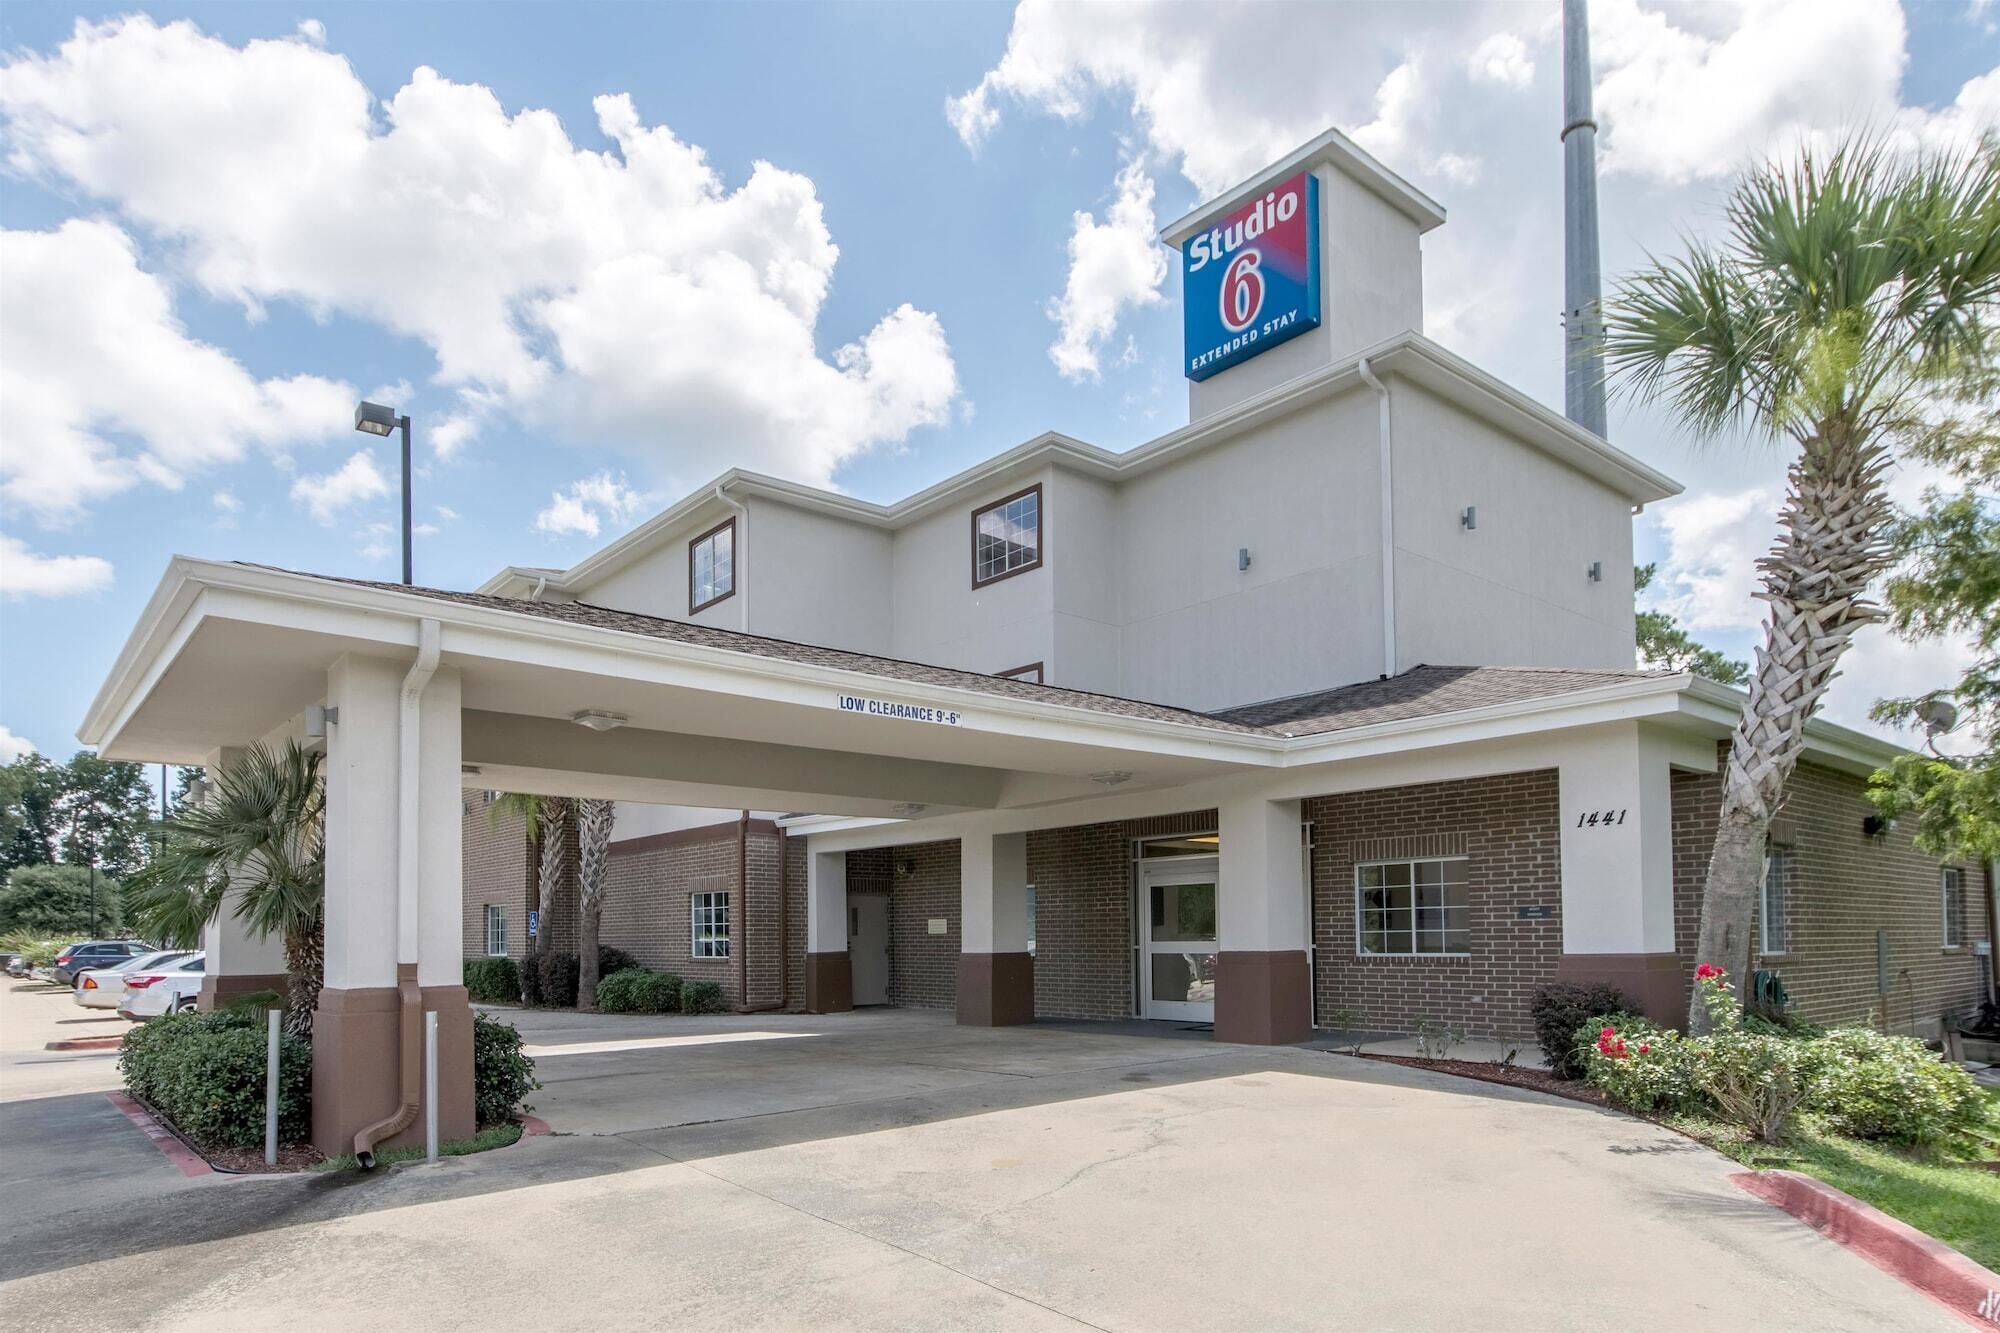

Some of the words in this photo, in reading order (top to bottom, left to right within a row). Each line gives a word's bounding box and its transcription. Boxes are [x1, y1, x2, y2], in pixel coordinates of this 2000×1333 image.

[1189, 191, 1298, 273] Studio
[1219, 247, 1265, 334] 6
[1191, 329, 1259, 370] EXTENDED
[1263, 309, 1298, 336] STAY
[840, 695, 865, 712] LOW
[869, 700, 933, 721] CLEARANCE
[1577, 809, 1627, 828] 1441
